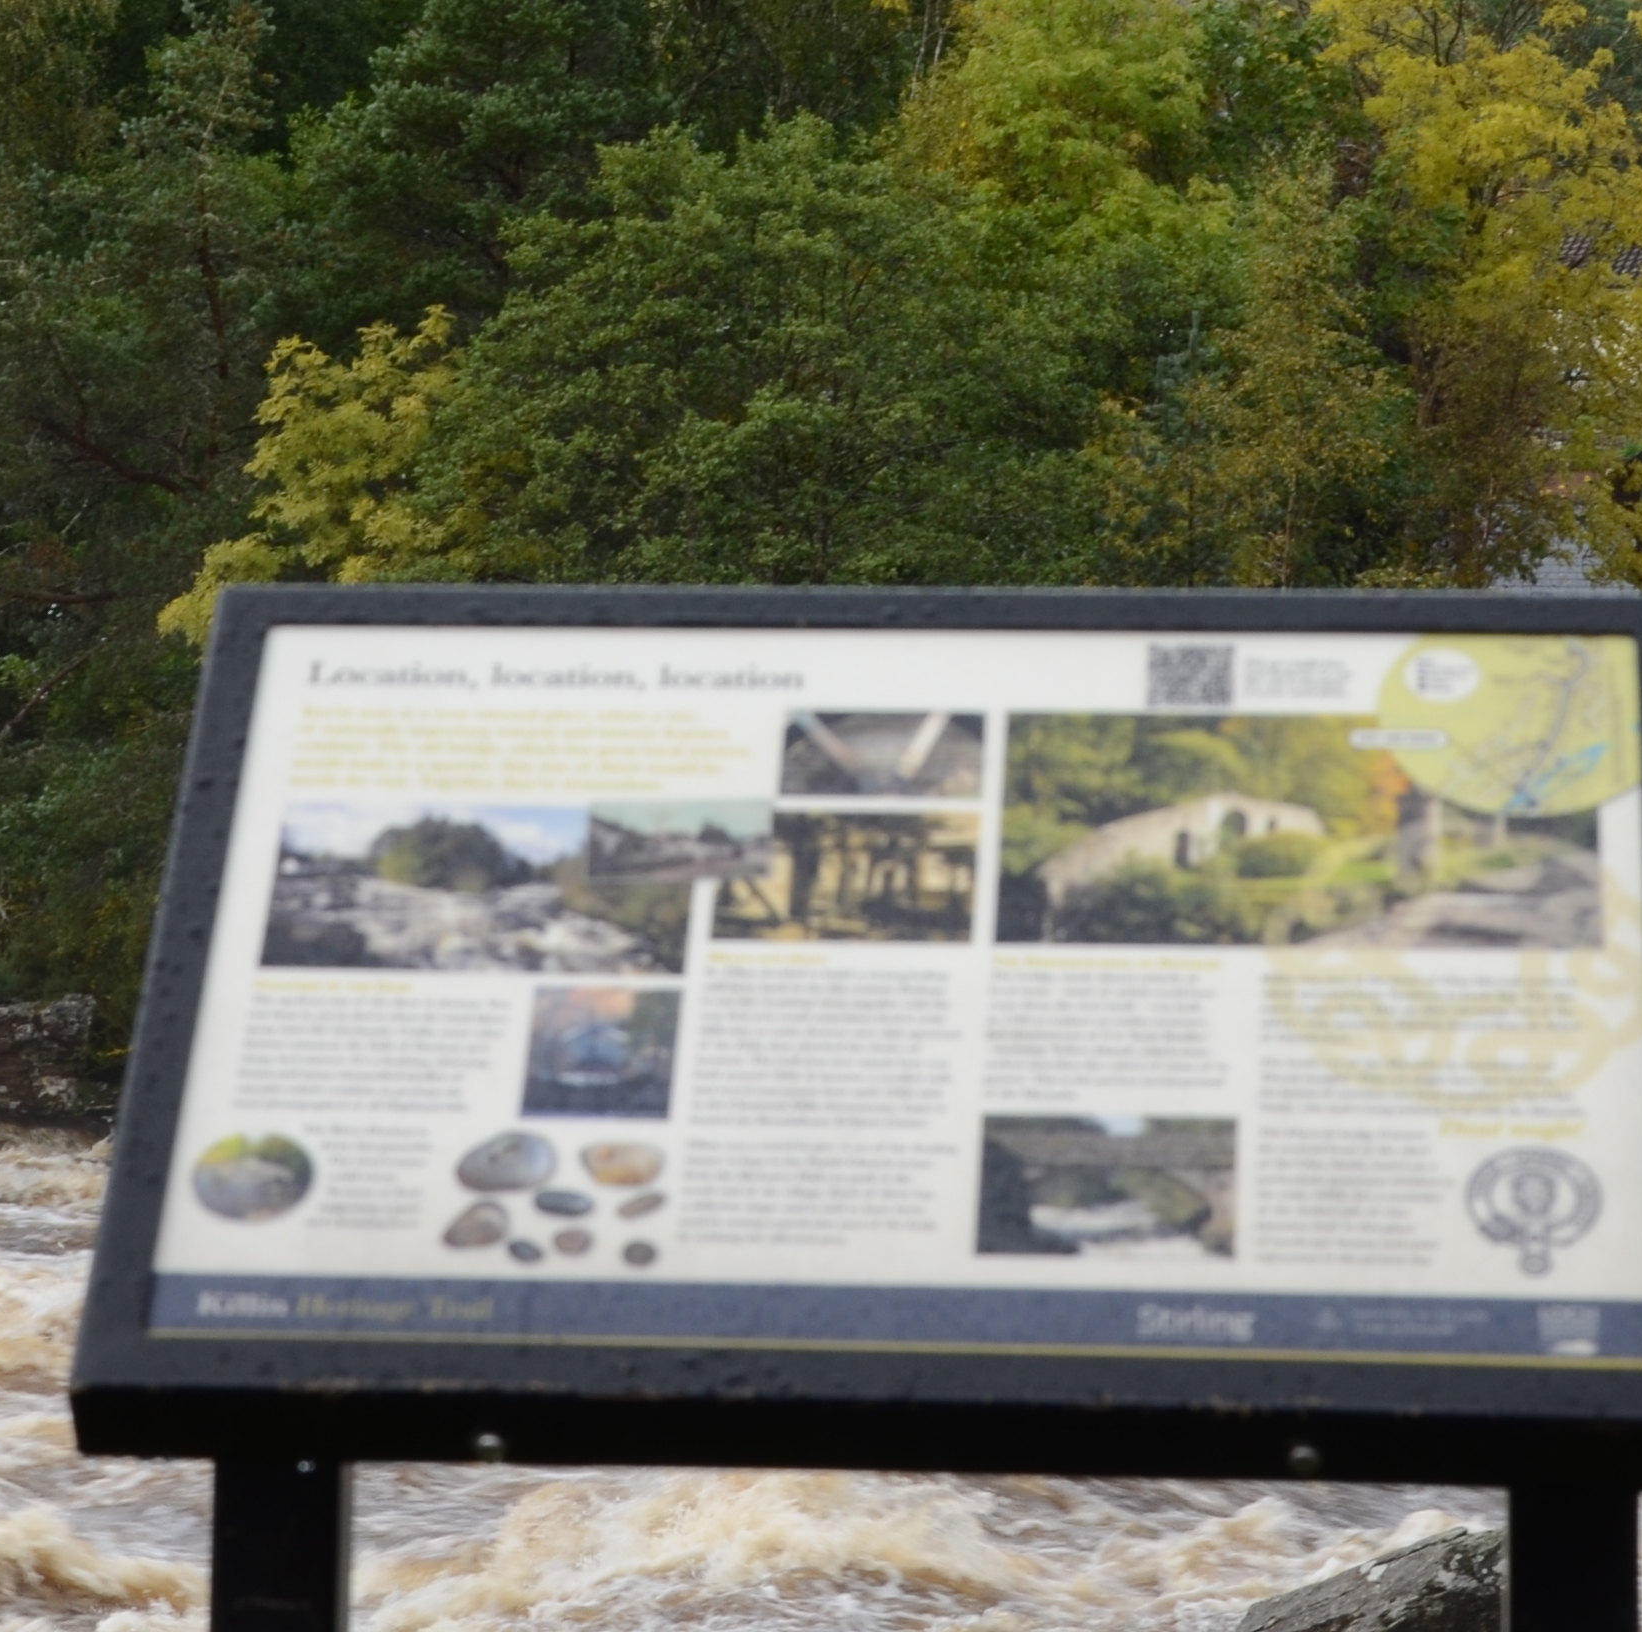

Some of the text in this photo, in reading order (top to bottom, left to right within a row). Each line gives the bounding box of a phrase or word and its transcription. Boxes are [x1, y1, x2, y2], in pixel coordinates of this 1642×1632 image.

[307, 660, 805, 692] Location, location, location
